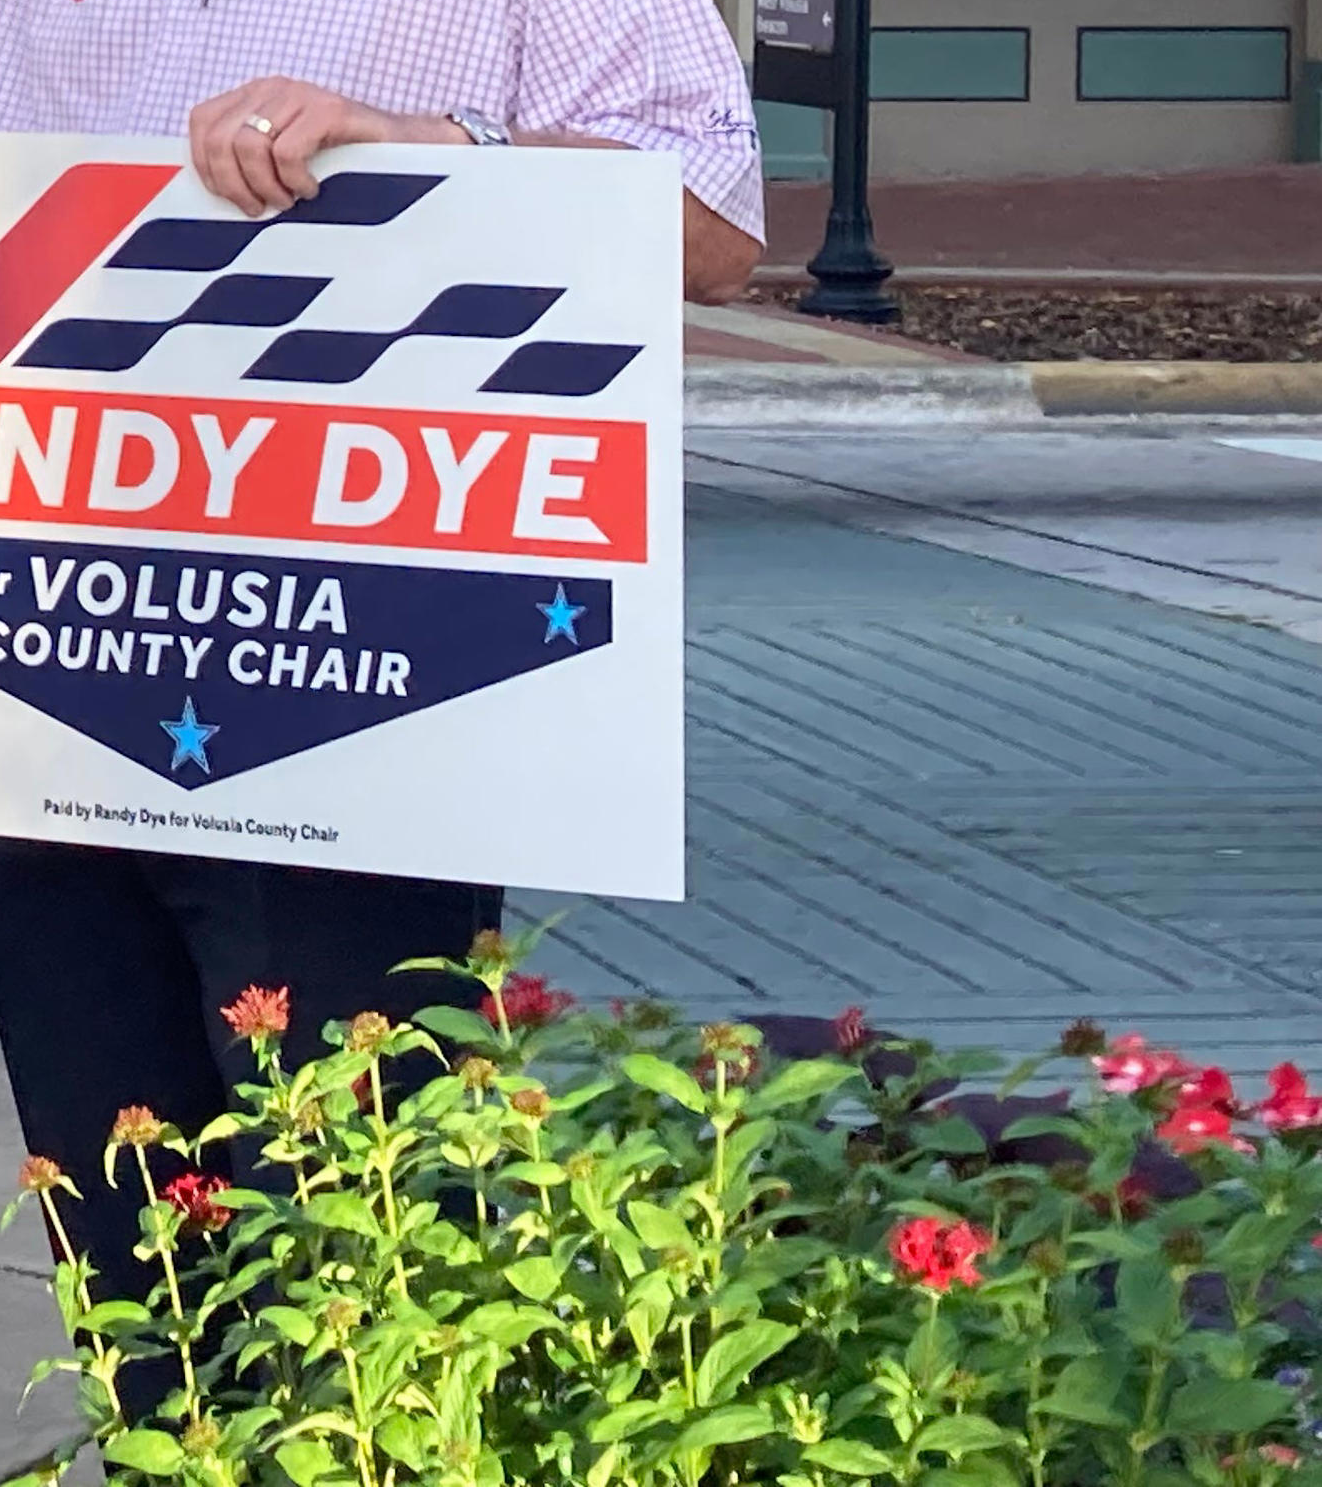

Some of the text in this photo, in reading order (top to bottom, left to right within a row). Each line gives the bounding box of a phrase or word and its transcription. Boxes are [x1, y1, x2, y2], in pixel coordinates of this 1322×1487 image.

[312, 422, 613, 544] DYE
[29, 555, 349, 635] VOLUSIA
[227, 639, 413, 698] CHAIR
[44, 798, 340, 843] Paid by Randy Dye for Volusia County Chair
